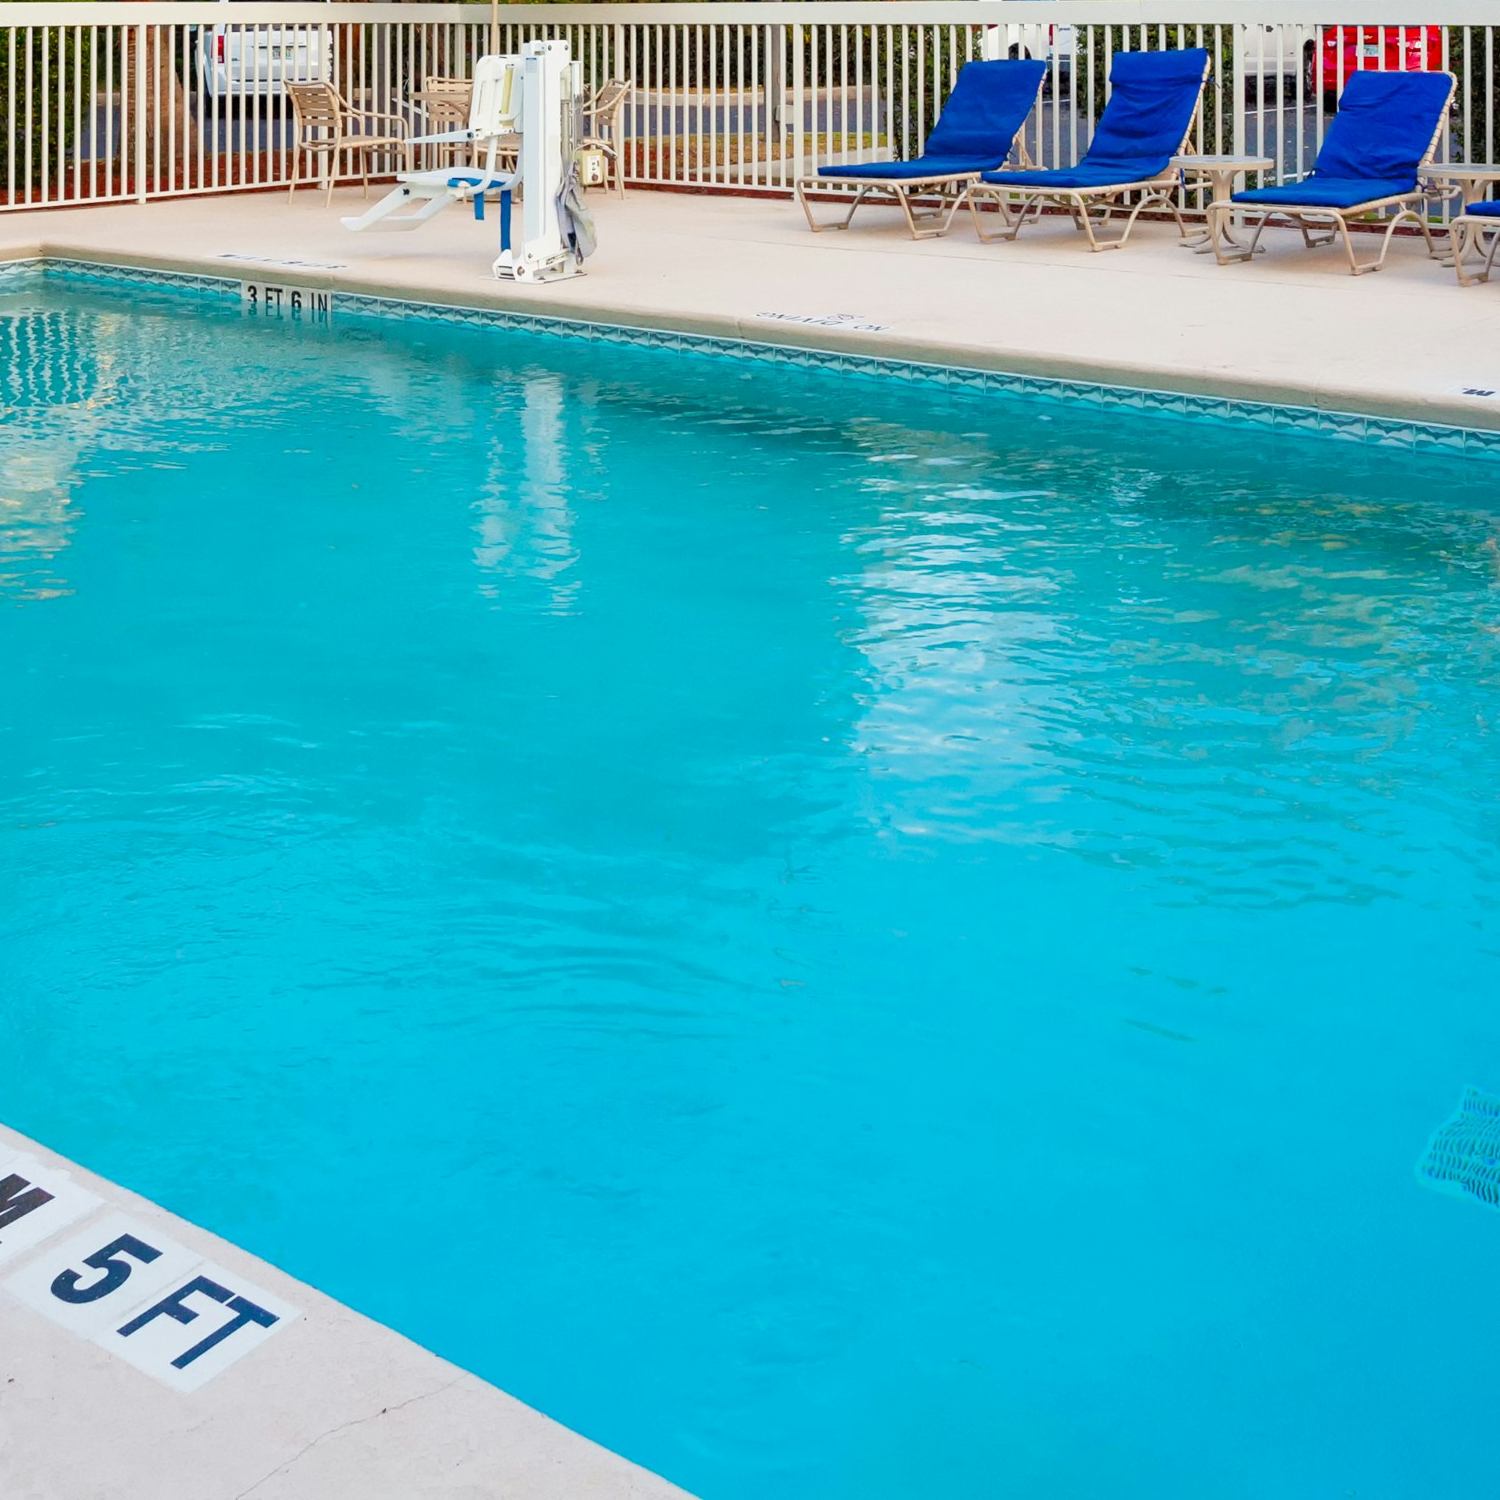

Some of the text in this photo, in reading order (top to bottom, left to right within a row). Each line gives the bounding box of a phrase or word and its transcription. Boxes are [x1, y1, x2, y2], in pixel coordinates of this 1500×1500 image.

[247, 285, 328, 312] 3 FT 6 IN
[49, 1233, 164, 1304] 5
[116, 1275, 281, 1370] FT
